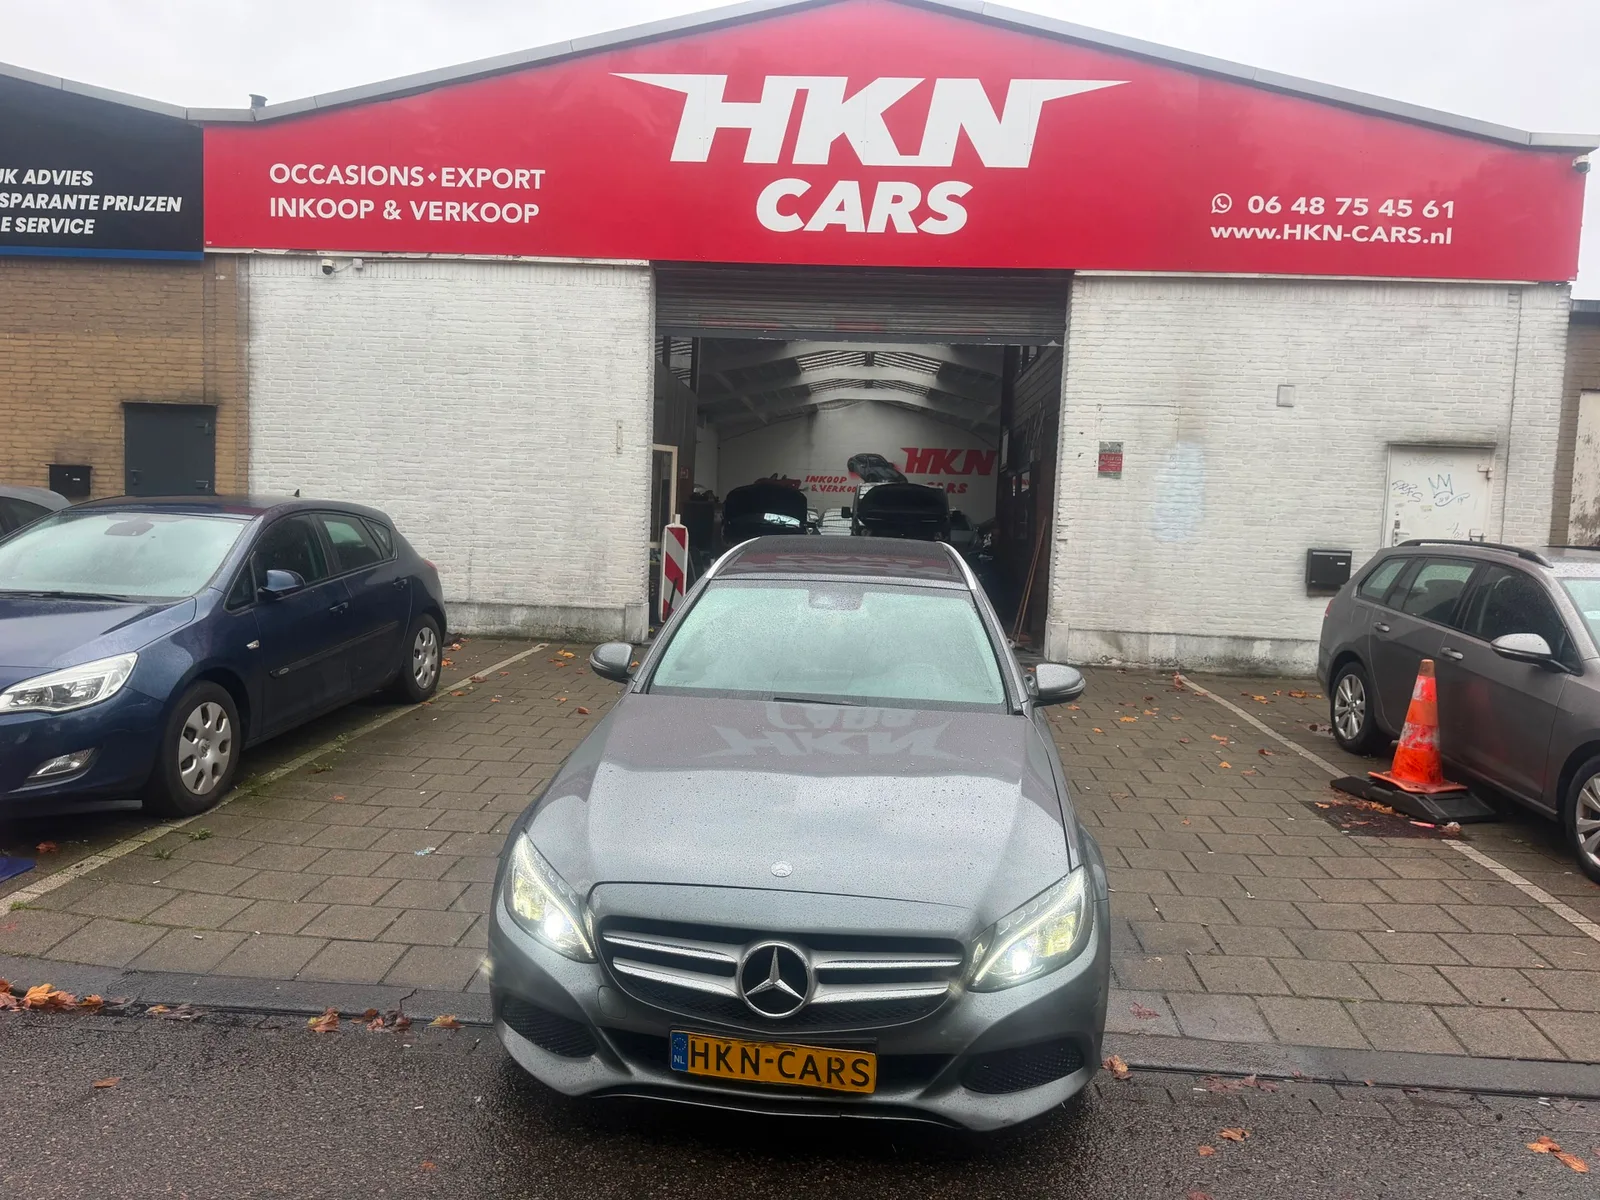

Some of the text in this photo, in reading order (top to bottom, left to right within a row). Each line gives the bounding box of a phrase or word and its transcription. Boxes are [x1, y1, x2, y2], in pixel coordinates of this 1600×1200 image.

[608, 72, 1132, 169] HKN
[22, 168, 94, 187] ADVIES
[269, 163, 546, 190] OCCASIONS EXPORT
[0, 192, 182, 213] SPARANTE PRIJZEN
[269, 197, 540, 224] INKOOP & VERKOOP
[756, 177, 974, 235] CARS
[1247, 195, 1454, 219] 06 48 75 45 61
[15, 217, 96, 235] SERVICE
[1210, 223, 1453, 245] www.HKN-CARS.nl
[900, 447, 998, 476] HKN
[804, 475, 847, 484] INKOOP
[673, 1054, 685, 1065] NL
[690, 1040, 870, 1087] HKN-CARS
